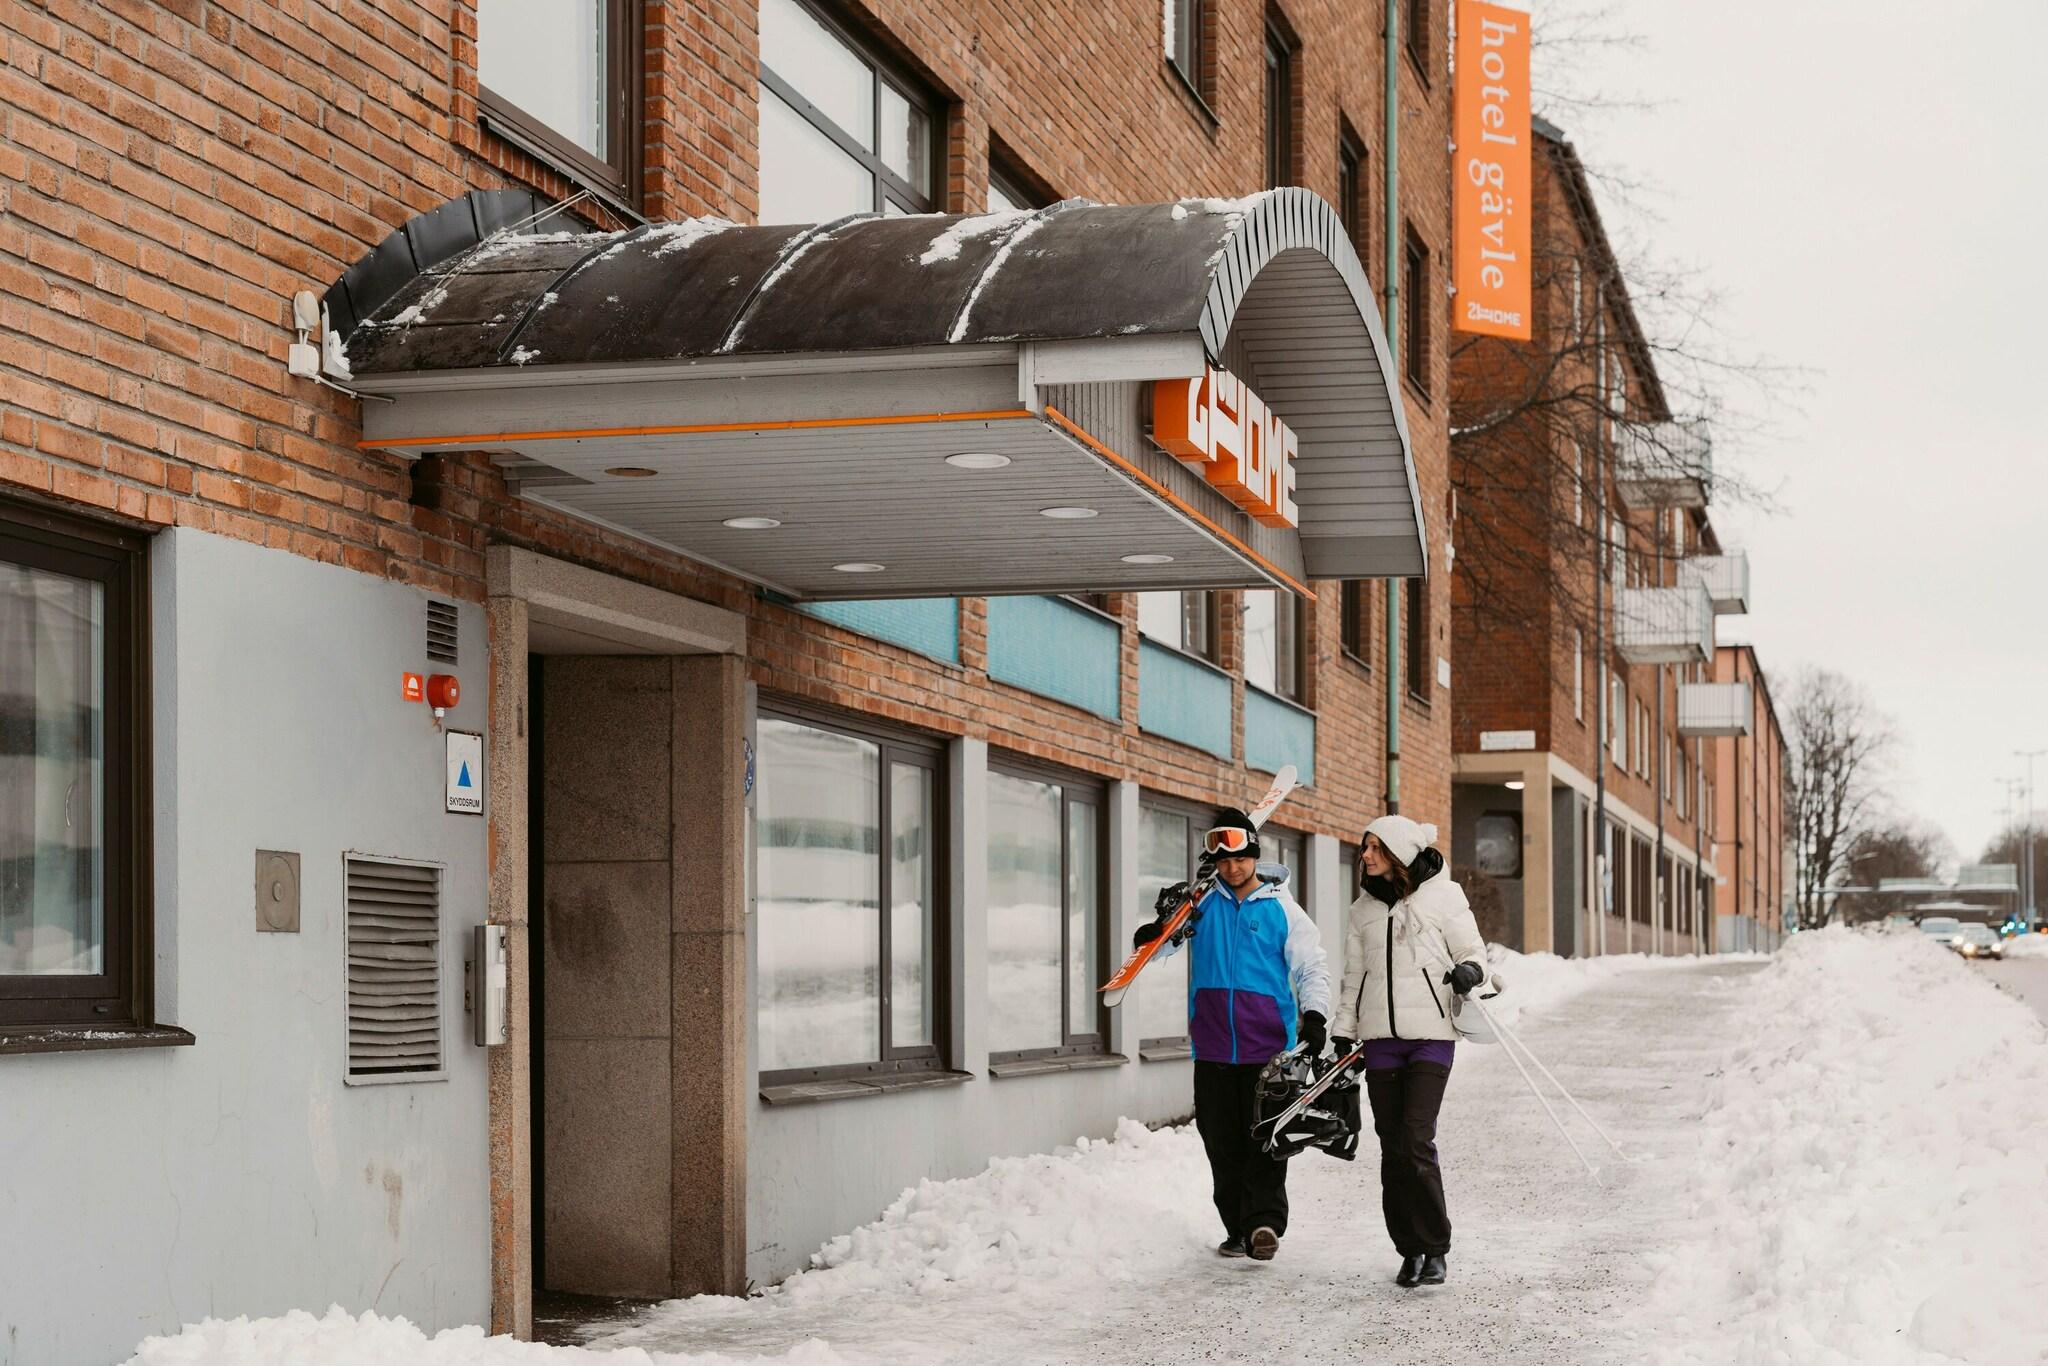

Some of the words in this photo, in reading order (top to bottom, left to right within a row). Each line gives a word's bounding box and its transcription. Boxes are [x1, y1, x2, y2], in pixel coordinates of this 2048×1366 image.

[1480, 16, 1518, 145] hotel
[1468, 158, 1517, 289] gävle
[449, 796, 480, 808] SKYDDSRUM
